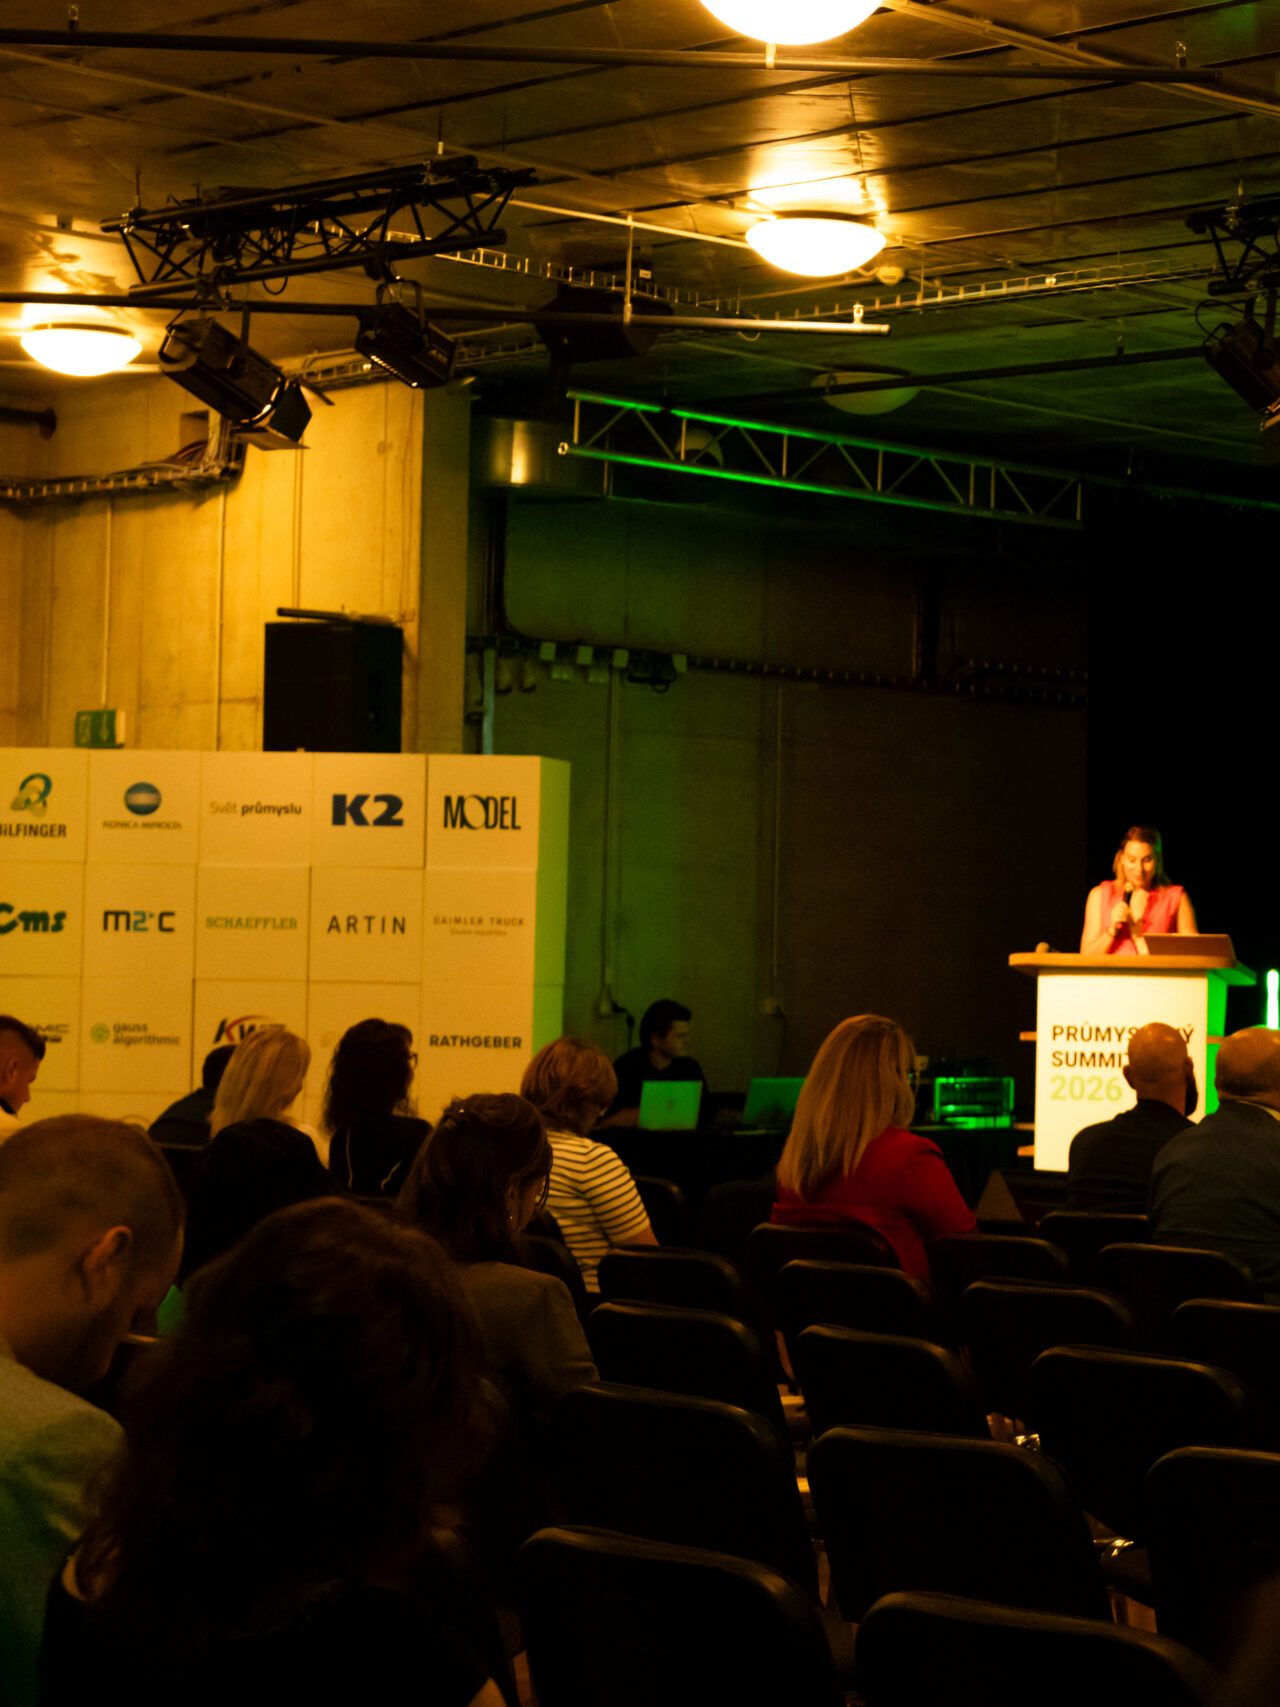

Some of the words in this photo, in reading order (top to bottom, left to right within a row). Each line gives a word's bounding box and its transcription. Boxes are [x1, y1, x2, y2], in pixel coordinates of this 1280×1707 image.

[241, 802, 302, 816] průmyslu
[331, 794, 404, 826] K2
[443, 795, 521, 829] MODEL
[0, 823, 67, 837] iLFINGER
[206, 916, 297, 930] SCHAEFFLER
[327, 915, 406, 934] ARTIN
[429, 1035, 522, 1049] RATHGEBER
[1050, 1075, 1123, 1102] 2026
